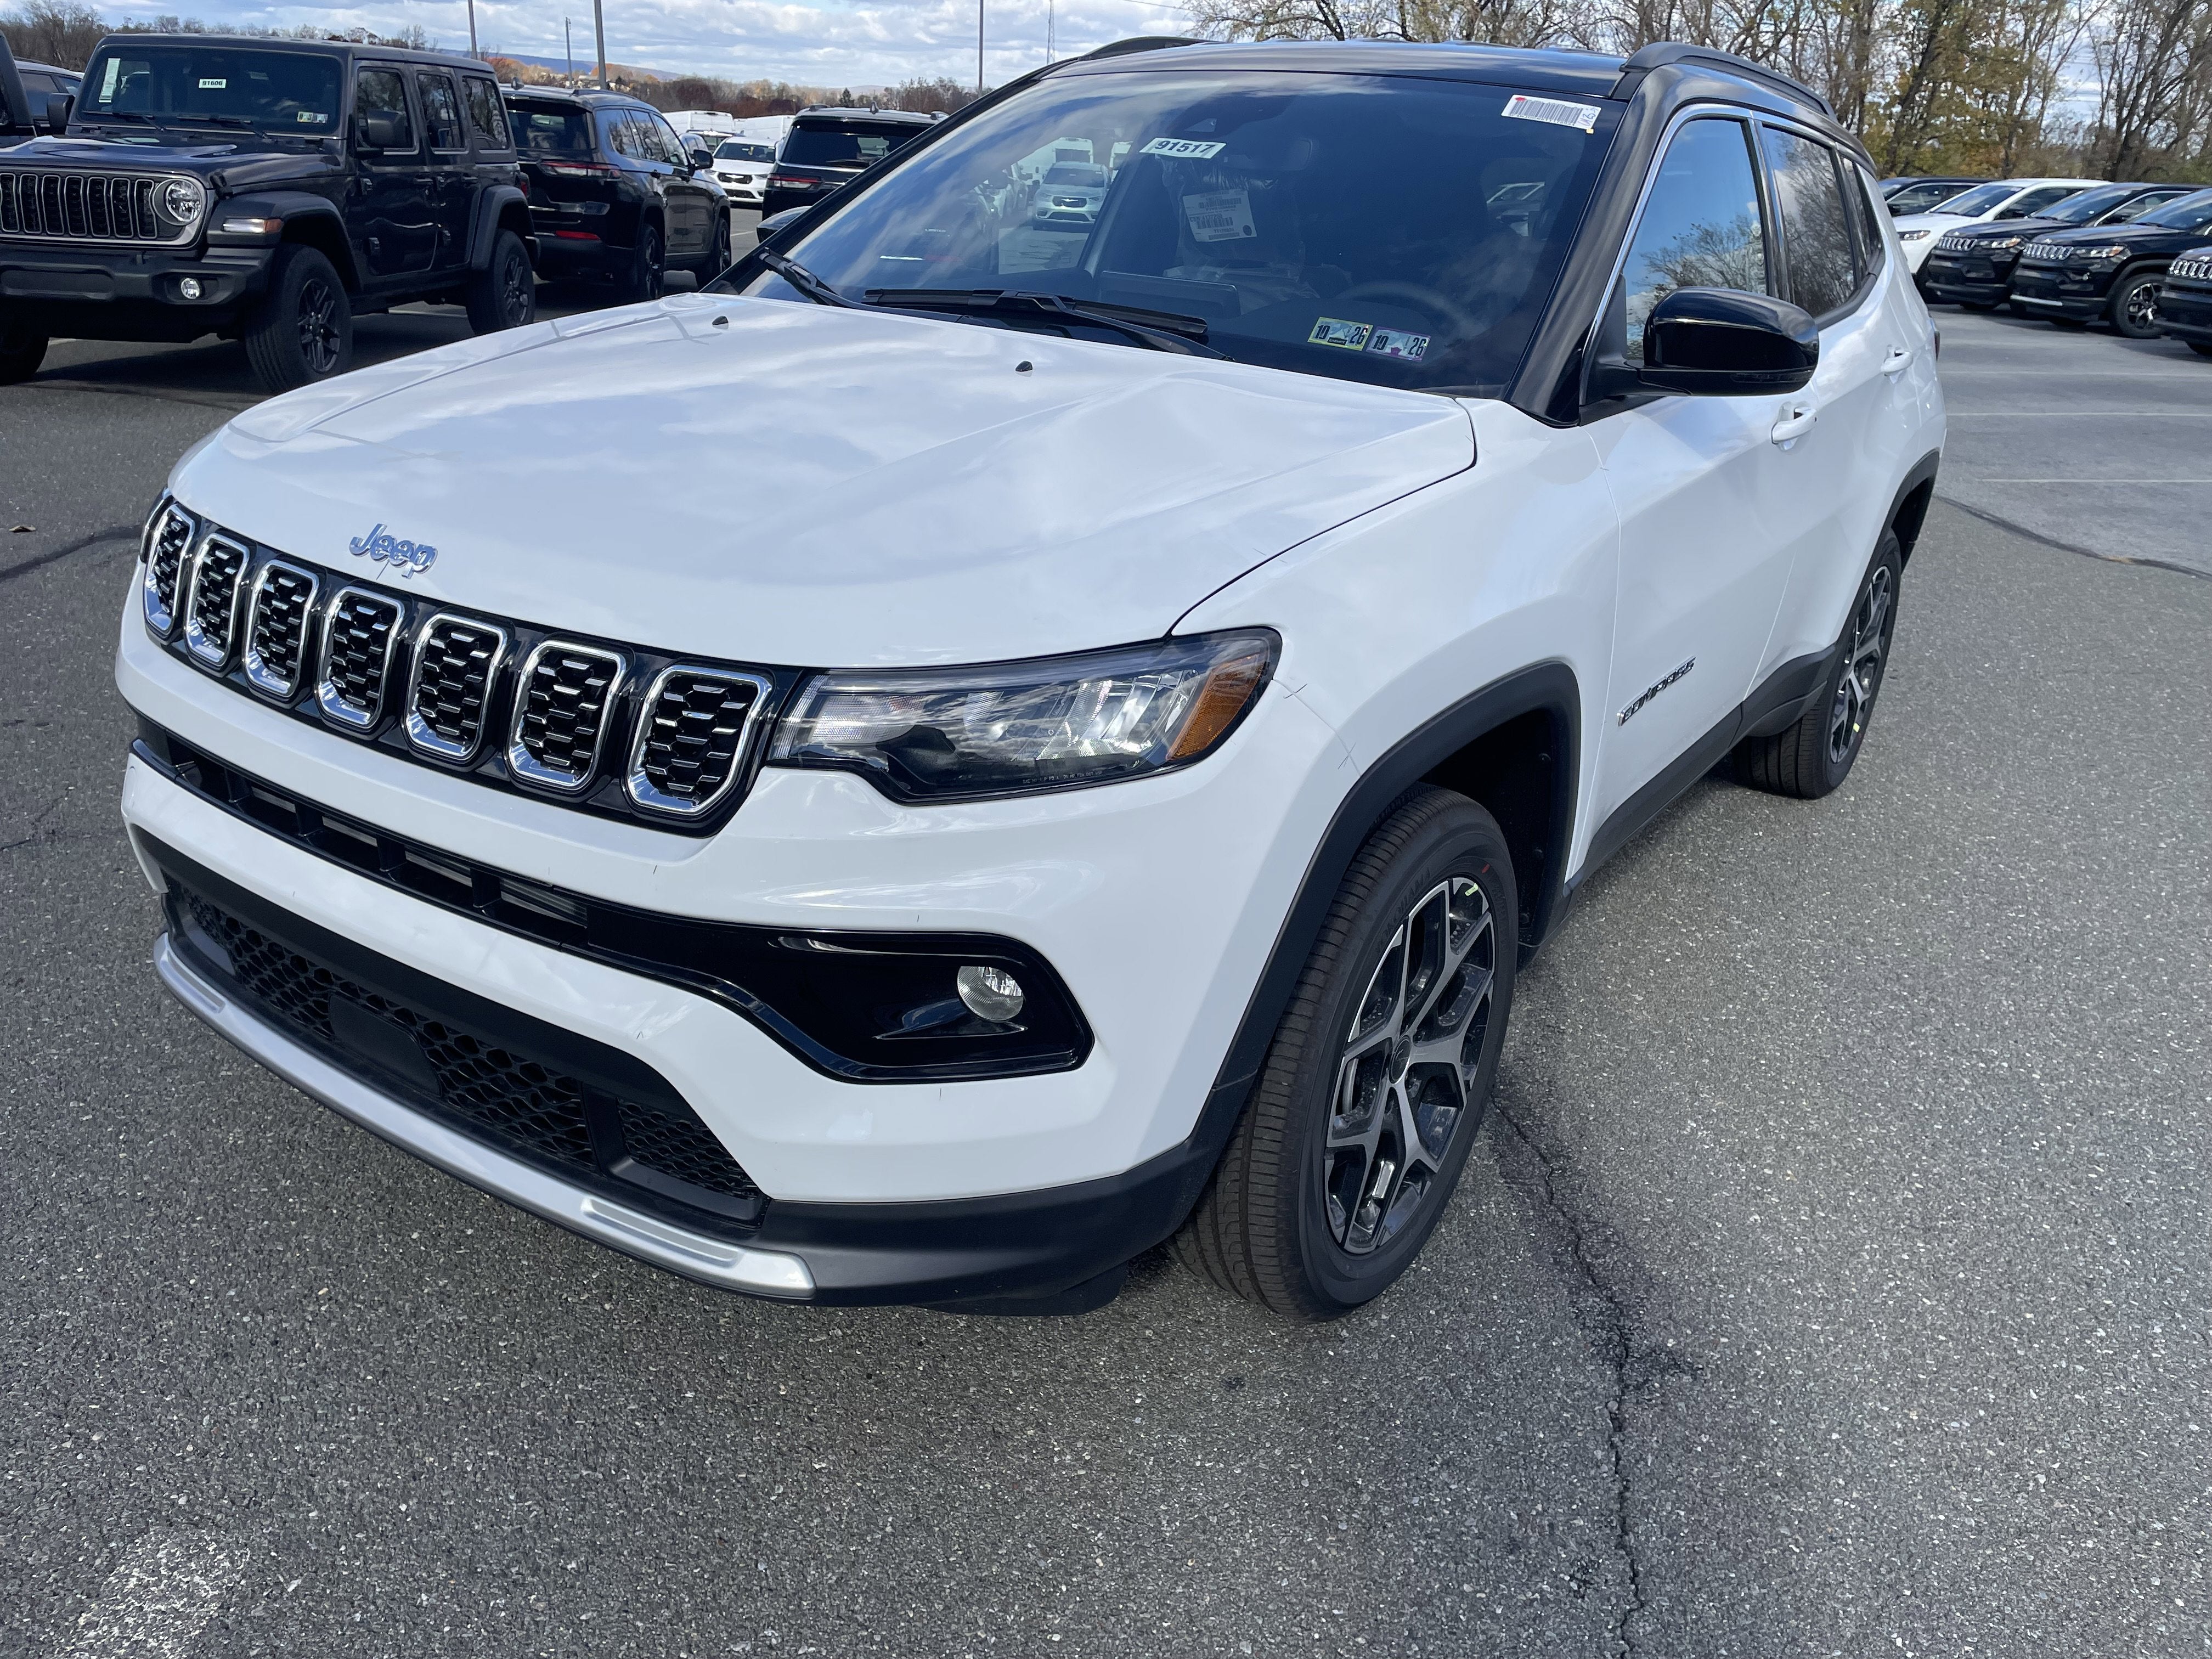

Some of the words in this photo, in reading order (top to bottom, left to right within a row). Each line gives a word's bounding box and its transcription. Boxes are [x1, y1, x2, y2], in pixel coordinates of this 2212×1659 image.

[1155, 140, 1216, 153] 91517
[1315, 324, 1330, 340] 10
[1349, 326, 1368, 345] 26
[1373, 334, 1389, 351] 10
[1408, 337, 1427, 357] 26
[349, 523, 438, 579] Jeep
